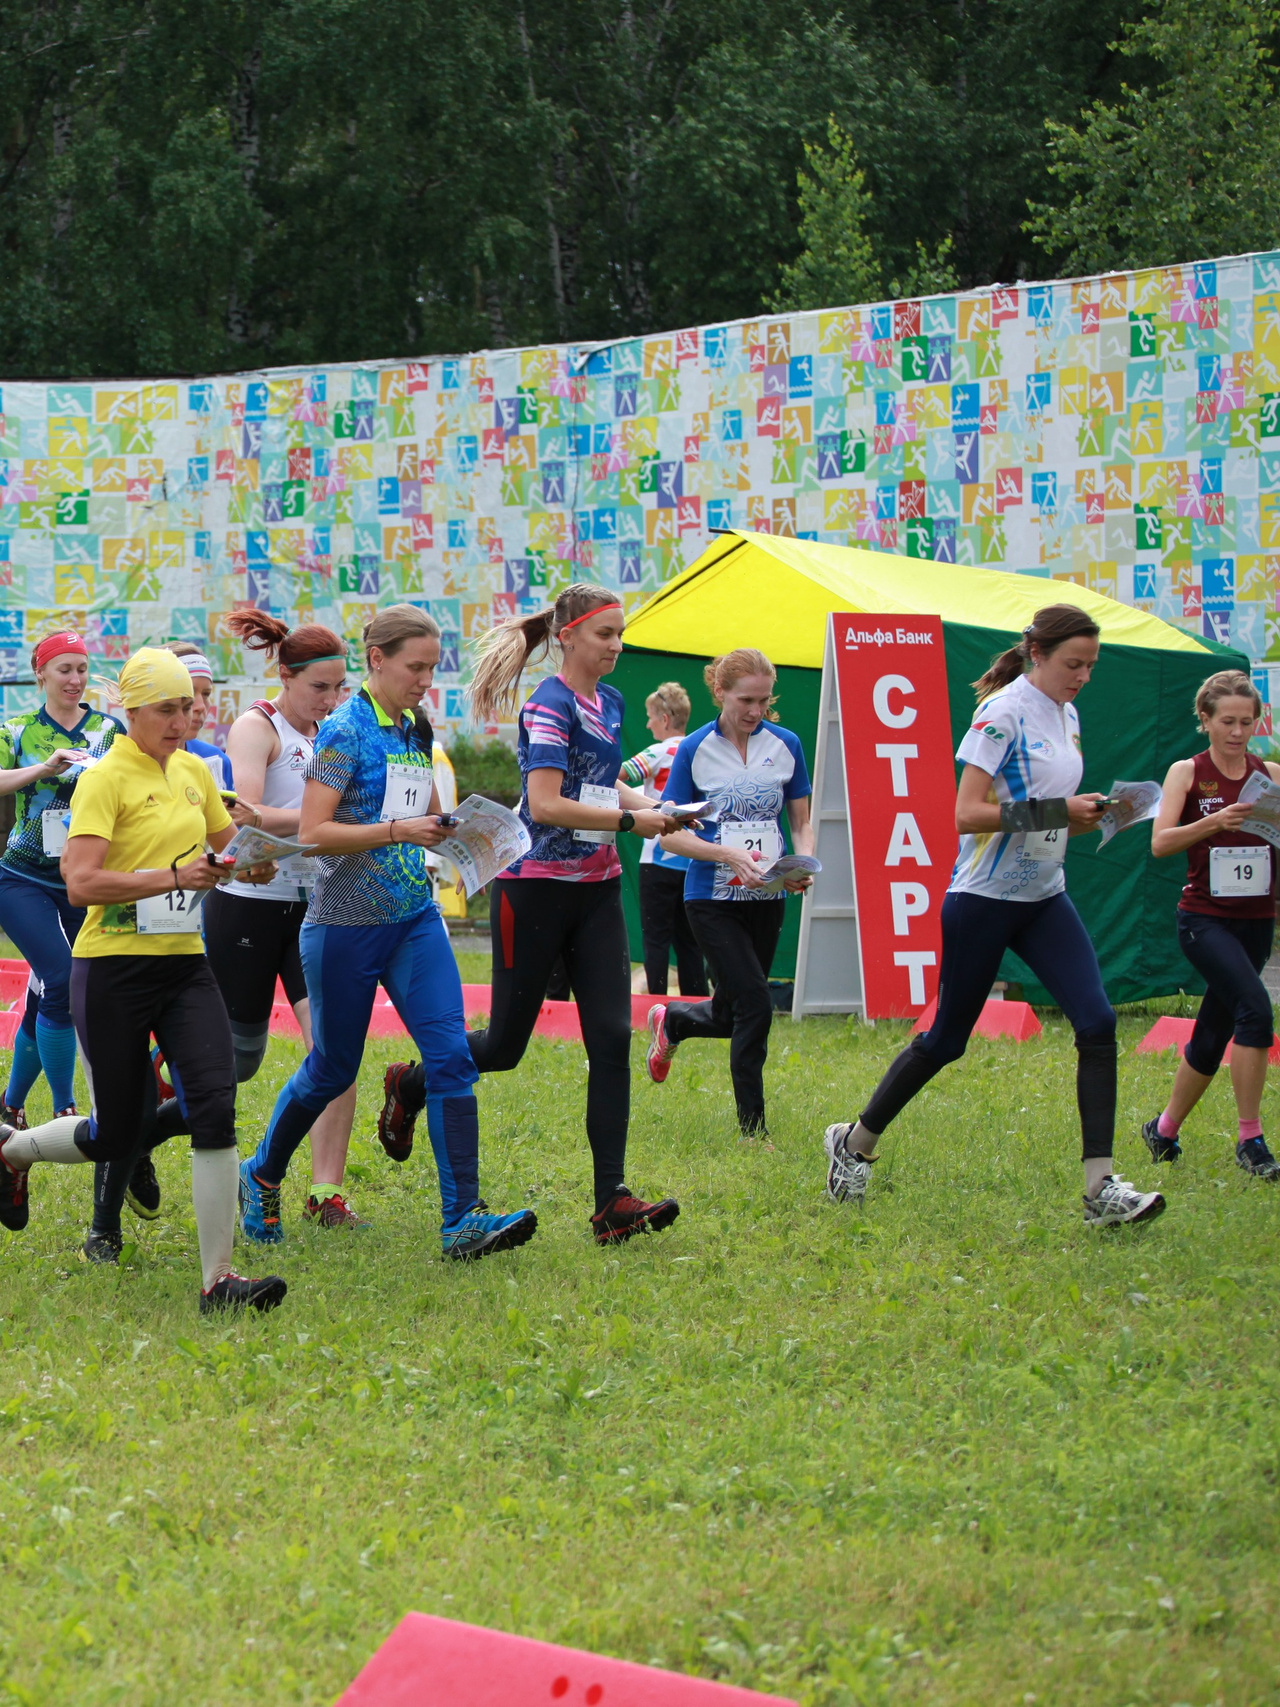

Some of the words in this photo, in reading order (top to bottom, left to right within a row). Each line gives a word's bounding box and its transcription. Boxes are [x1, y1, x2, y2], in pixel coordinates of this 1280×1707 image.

[845, 627, 894, 649] Альфа
[896, 628, 934, 645] Банк
[404, 788, 417, 807] 11
[1198, 797, 1224, 805] LUKOIL
[744, 838, 762, 852] 21
[873, 674, 936, 1006] СТАРТ
[1233, 864, 1253, 880] 19
[165, 890, 186, 911] 12
